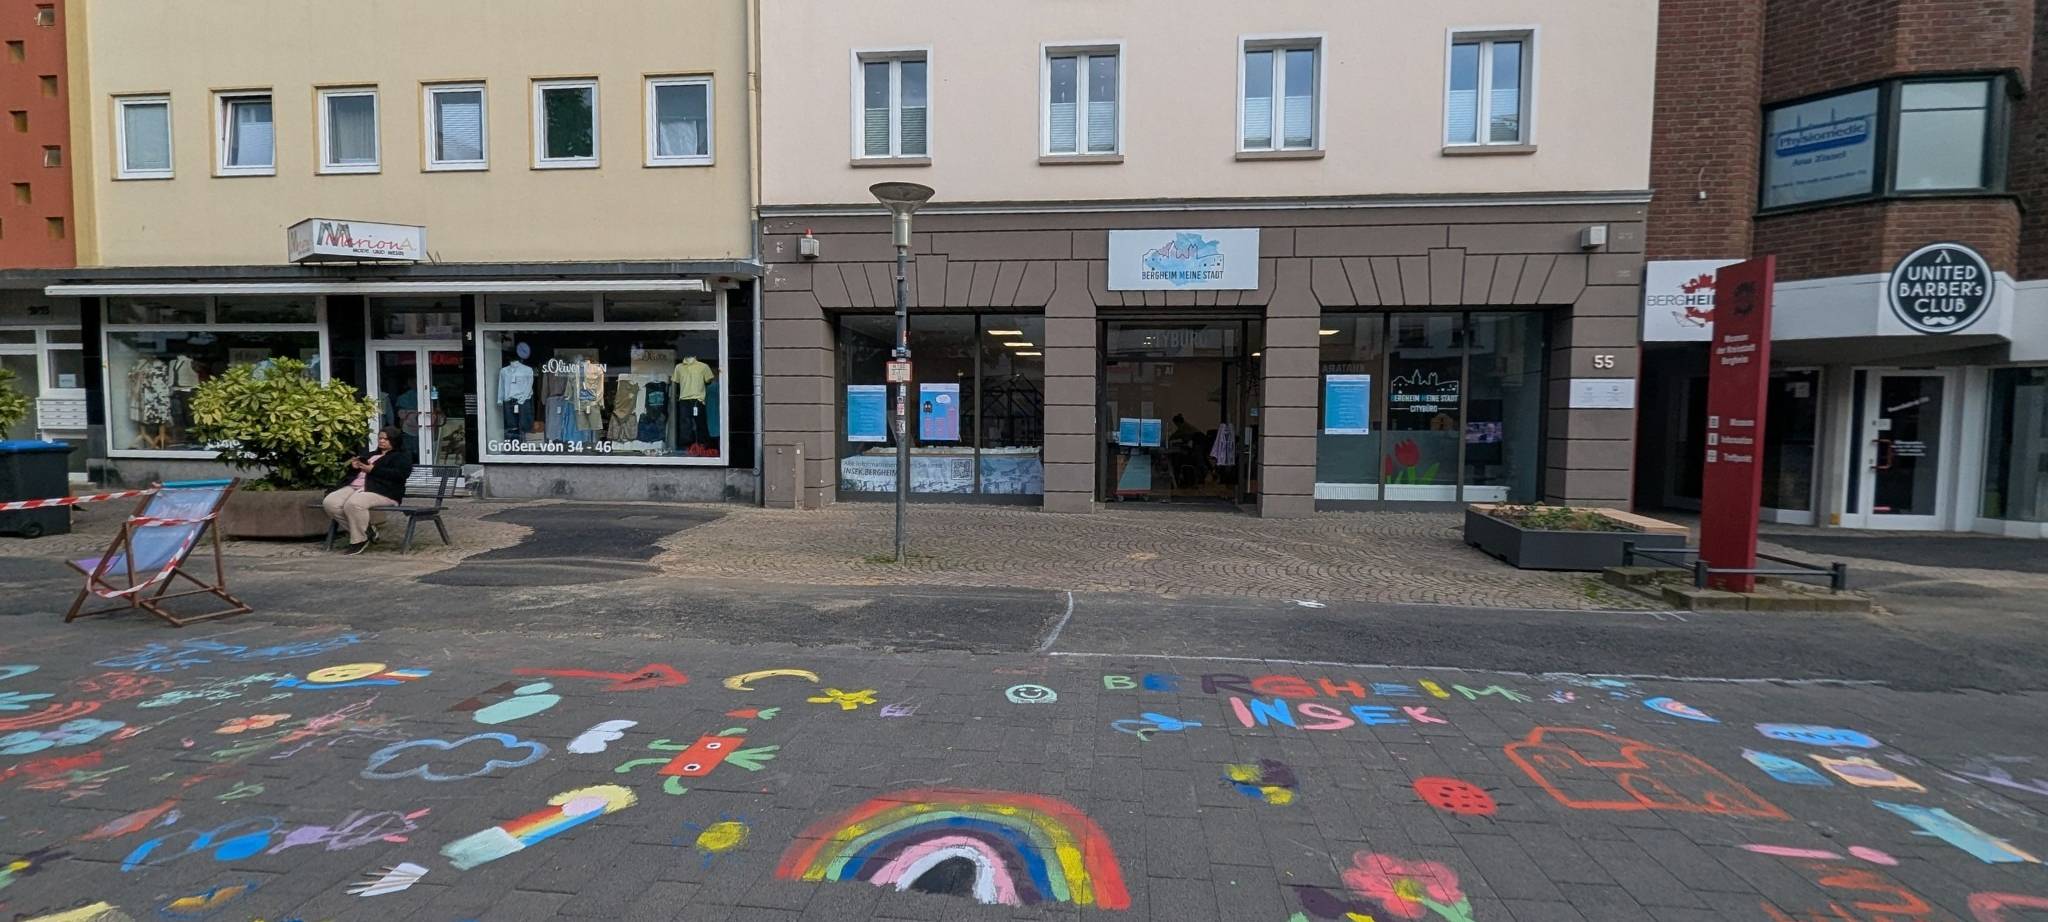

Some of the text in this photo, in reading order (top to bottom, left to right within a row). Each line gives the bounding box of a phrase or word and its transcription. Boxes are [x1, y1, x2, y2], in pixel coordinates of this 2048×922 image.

[1142, 270, 1224, 280] BERGHEIM MEINE STADT
[1907, 265, 1977, 281] UNITED
[1914, 298, 1967, 313] CLUB
[1594, 354, 1615, 369] 55
[1391, 394, 1459, 402] BERGHEIM MEINE STADT
[1409, 404, 1438, 413] CITYBÜRO
[488, 439, 540, 452] Größen
[540, 442, 564, 452] von
[567, 441, 583, 452] 34
[595, 441, 612, 452] 46
[1104, 673, 1532, 703] BERGHEIM
[1229, 697, 1450, 731] INSEK
